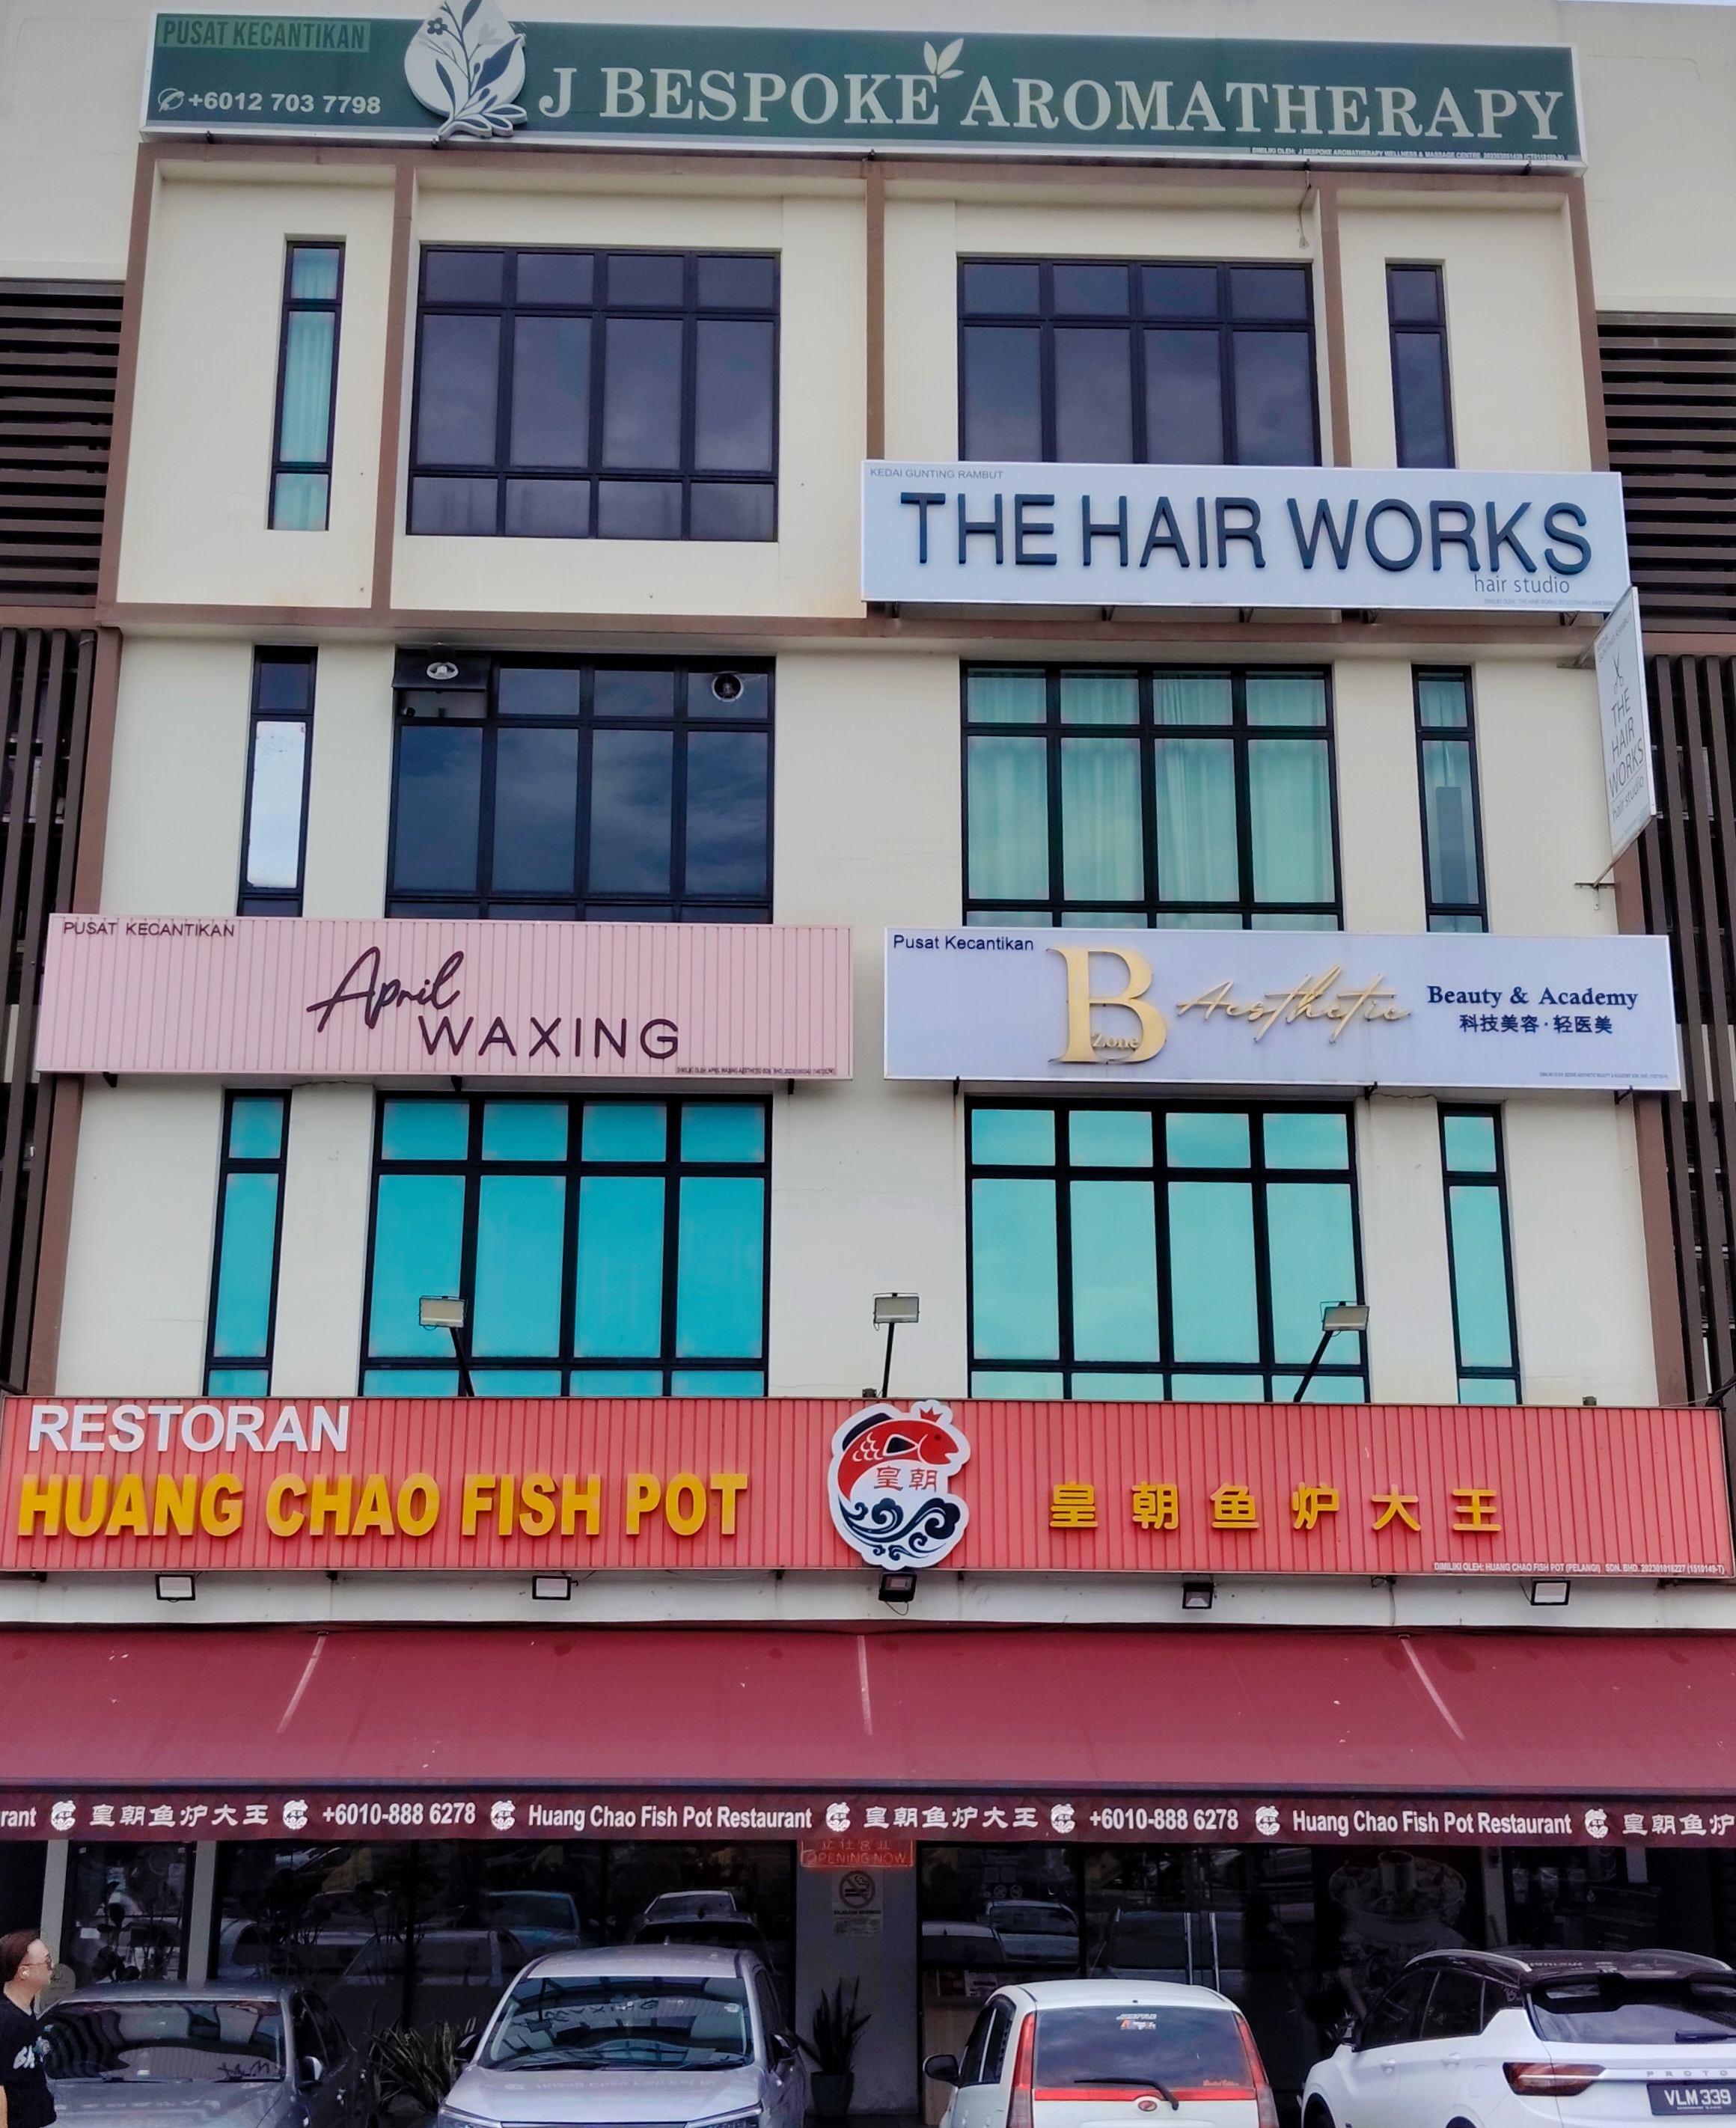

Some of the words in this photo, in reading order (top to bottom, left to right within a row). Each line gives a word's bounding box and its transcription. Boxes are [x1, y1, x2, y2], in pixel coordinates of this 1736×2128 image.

[163, 19, 228, 45] PUSAT
[233, 22, 365, 49] KECANTIKAN
[188, 92, 262, 111] +6012
[271, 94, 314, 112] 703
[323, 95, 381, 114] 7798
[539, 67, 577, 117] J
[600, 67, 939, 125] BESPOKE
[960, 76, 1564, 140] AROMATHERAPY
[1333, 149, 1384, 157] AROMATHERAPY
[870, 468, 902, 477] KEDAI
[905, 469, 955, 478] GUNTING
[958, 471, 1003, 479] RAMBUT
[900, 492, 1057, 566] THE
[1081, 495, 1266, 569] HAIR
[1286, 497, 1592, 576] WORKS
[1474, 574, 1507, 592] hair
[1514, 575, 1570, 593] studio
[1611, 688, 1631, 727] THE
[1611, 717, 1635, 763] HAIR
[1609, 737, 1645, 798] WORKS
[64, 922, 117, 935] PUSAT
[126, 923, 234, 936] KECANTIKAN
[893, 935, 940, 949] Pusat
[945, 935, 1033, 950] Kecantikan
[306, 947, 464, 1033] April
[1427, 985, 1503, 1008] Beauty
[1510, 986, 1529, 1004] &
[1538, 987, 1638, 1010] Academy
[1046, 947, 1167, 1063] B
[1176, 963, 1413, 1043] Aesthetic
[418, 1016, 679, 1060] WAXING
[1091, 1033, 1140, 1048] Zone
[28, 1404, 349, 1452] RESTORAN
[874, 1465, 938, 1493] 皇朝
[18, 1473, 243, 1538] HUANG
[266, 1473, 440, 1538] CHAO
[462, 1473, 602, 1538] FISH
[626, 1473, 748, 1536] POT
[1049, 1482, 1502, 1531] 皇朝鱼炉大王
[1434, 1562, 1461, 1571] DIMILIKI
[1464, 1562, 1485, 1571] OLEH:
[1485, 1562, 1511, 1571] HUANG
[1512, 1562, 1532, 1571] CHAO
[1534, 1563, 1549, 1571] FISH
[1550, 1563, 1565, 1571] POT
[1566, 1562, 1601, 1574] (PELANGI)
[1605, 1564, 1621, 1572] SDN.
[1623, 1564, 1639, 1572] BHD.
[89, 1804, 269, 1827] 皇朝鱼炉大王
[323, 1803, 424, 1825] +6010-888
[430, 1803, 476, 1825] 6278
[528, 1805, 585, 1831] Huang
[590, 1805, 636, 1827] Chao
[641, 1806, 677, 1827] Fish
[683, 1806, 712, 1828] Pot
[717, 1807, 812, 1828] Restaurant
[863, 1806, 1039, 1829] 皇朝鱼炉大王
[1089, 1808, 1188, 1829] +6010-888
[1194, 1809, 1239, 1830] 6278
[1293, 1810, 1348, 1836] Huang
[1354, 1810, 1398, 1832] Chao
[1402, 1811, 1439, 1832] Fish
[1443, 1811, 1474, 1833] Pot
[1478, 1812, 1573, 1834] Restaurant
[1622, 1813, 1736, 1836] 皇朝鱼炉
[807, 1852, 869, 1864] OPENING
[874, 1852, 907, 1865] NOW
[1663, 2089, 1699, 2106] VLM
[1699, 2088, 1732, 2105] 339
